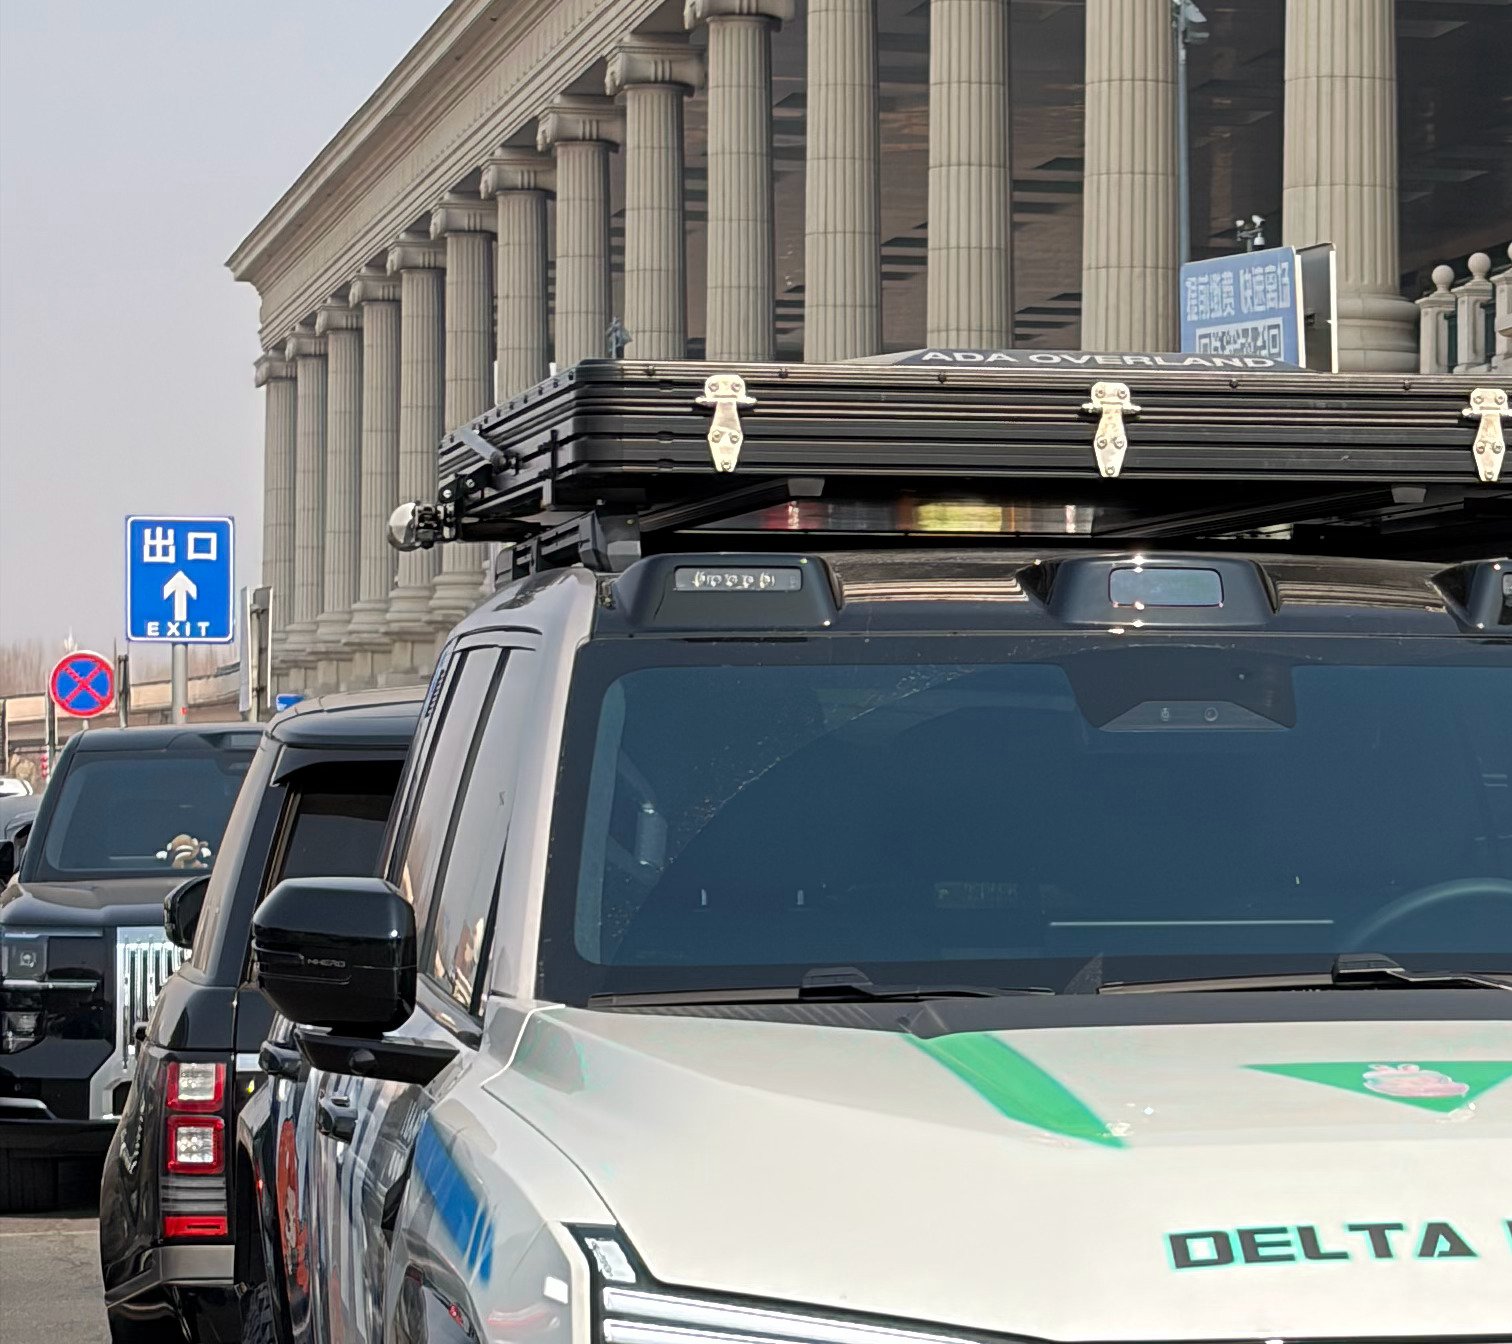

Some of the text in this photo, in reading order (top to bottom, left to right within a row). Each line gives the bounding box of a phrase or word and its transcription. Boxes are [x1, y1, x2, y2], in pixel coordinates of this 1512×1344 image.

[921, 350, 1276, 368] ADA OVERLAND
[143, 526, 217, 563] 出口
[147, 621, 210, 637] EXIT
[1168, 1222, 1479, 1270] DELTA
